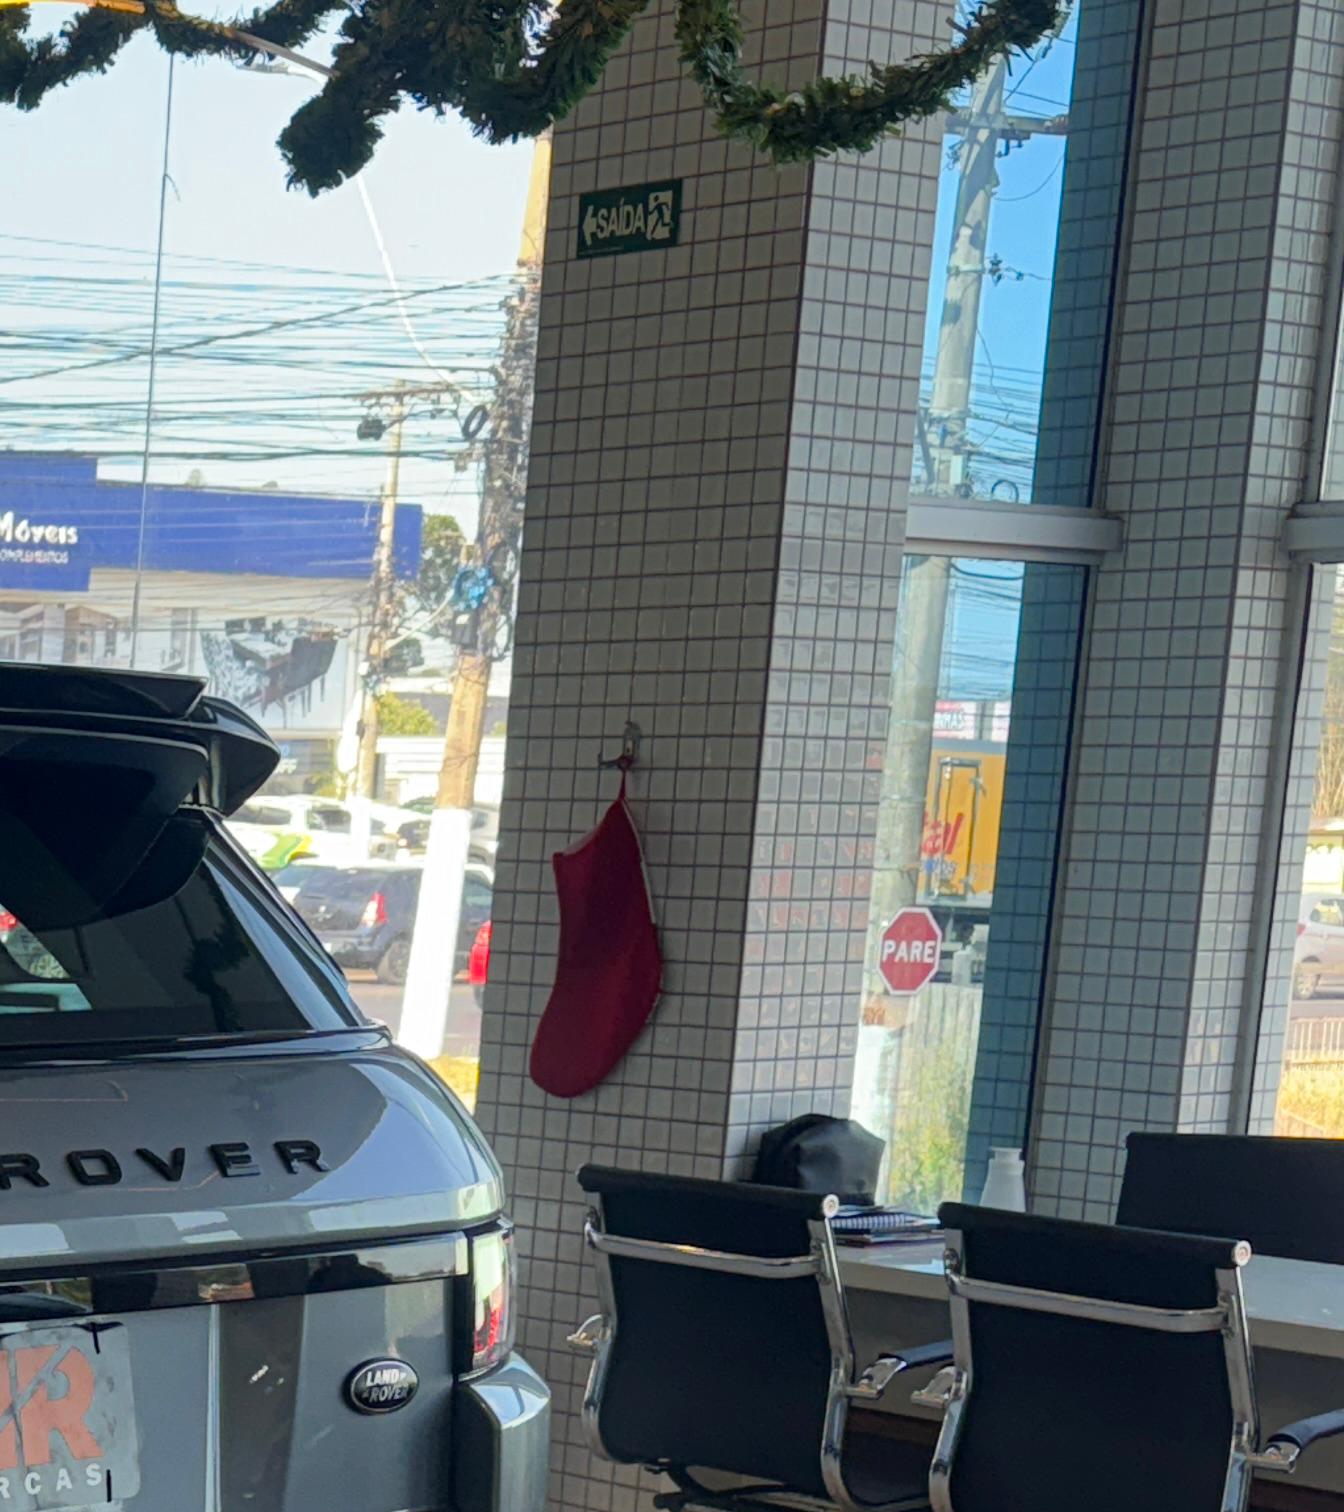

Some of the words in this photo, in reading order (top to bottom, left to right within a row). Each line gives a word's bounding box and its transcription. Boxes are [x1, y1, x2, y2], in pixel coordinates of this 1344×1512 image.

[597, 198, 646, 239] SAÍDA
[882, 940, 937, 964] PARE
[366, 1369, 400, 1386] LAND
[369, 1384, 409, 1403] ROVER
